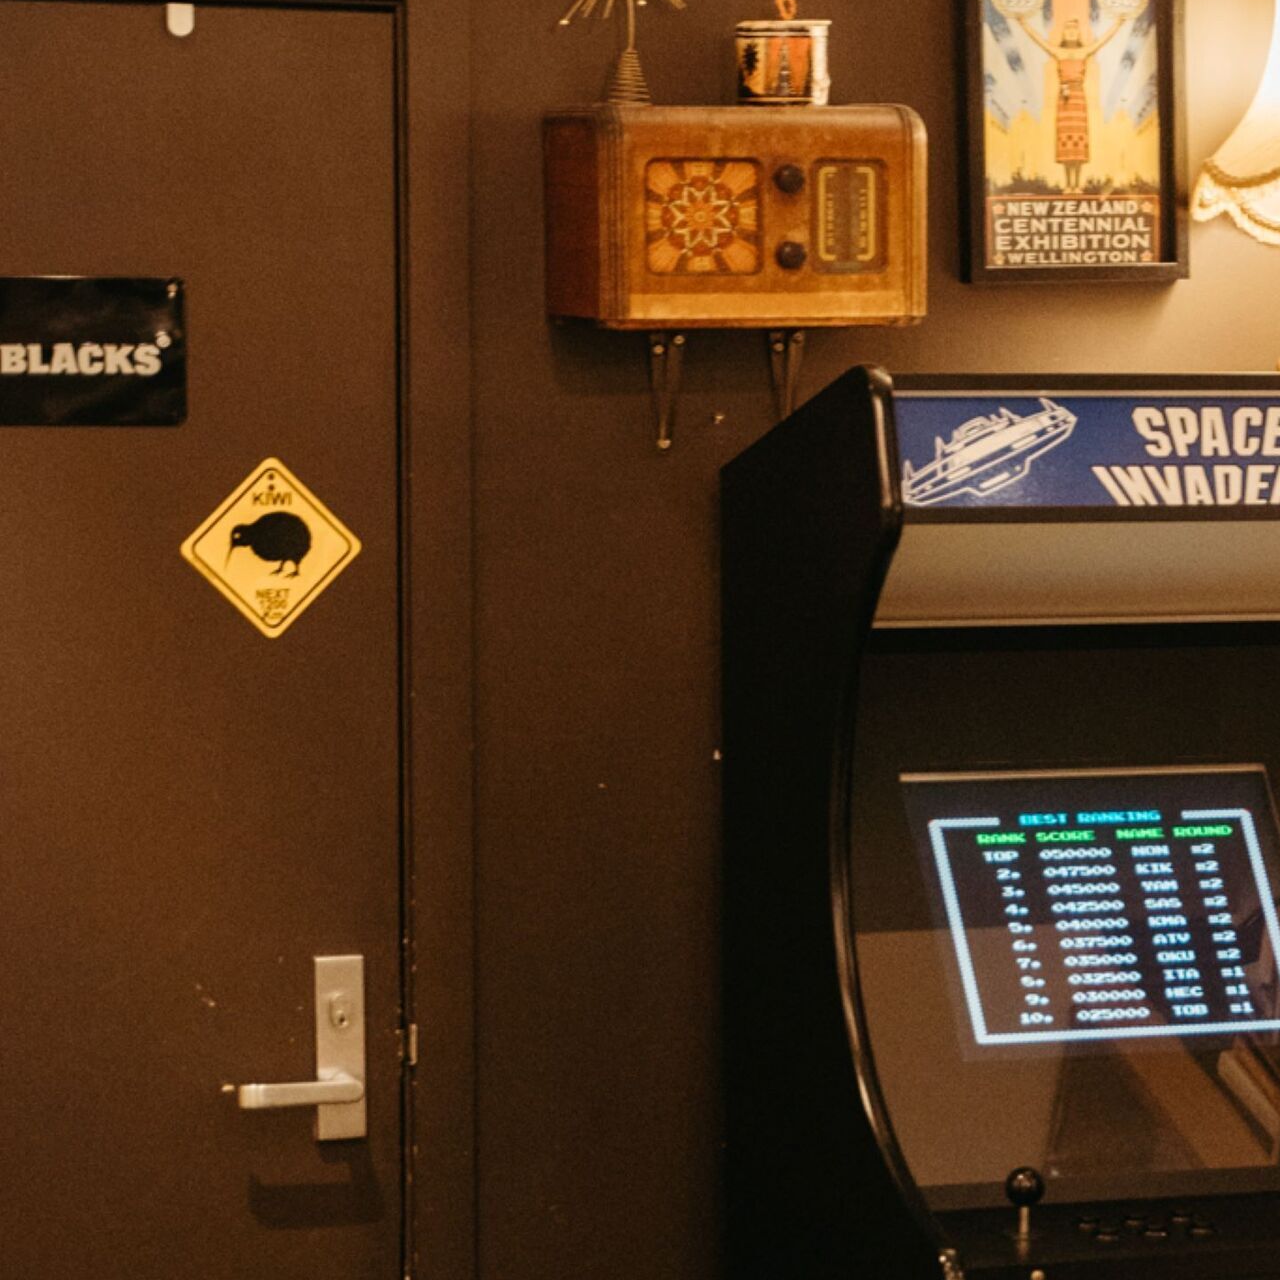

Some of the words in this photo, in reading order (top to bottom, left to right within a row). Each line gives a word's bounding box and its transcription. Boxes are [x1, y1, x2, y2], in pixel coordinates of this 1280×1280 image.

[1007, 201, 1050, 216] NEW
[1053, 200, 1138, 216] ZEALAND
[994, 217, 1151, 234] CENTENNIAL
[994, 234, 1151, 251] EXHIBITION
[1006, 251, 1138, 265] WELLINGTON
[0, 341, 162, 375] BLACKS
[252, 491, 293, 506] KIWI
[255, 588, 291, 600] NEXT
[1018, 813, 1067, 826] BEST
[1076, 810, 1162, 825] RANKING
[976, 832, 1026, 845] RANK
[1035, 829, 1096, 842] SCORE
[1115, 827, 1164, 839] NAME
[1172, 824, 1233, 838] ROUND
[982, 850, 1019, 862] TOP
